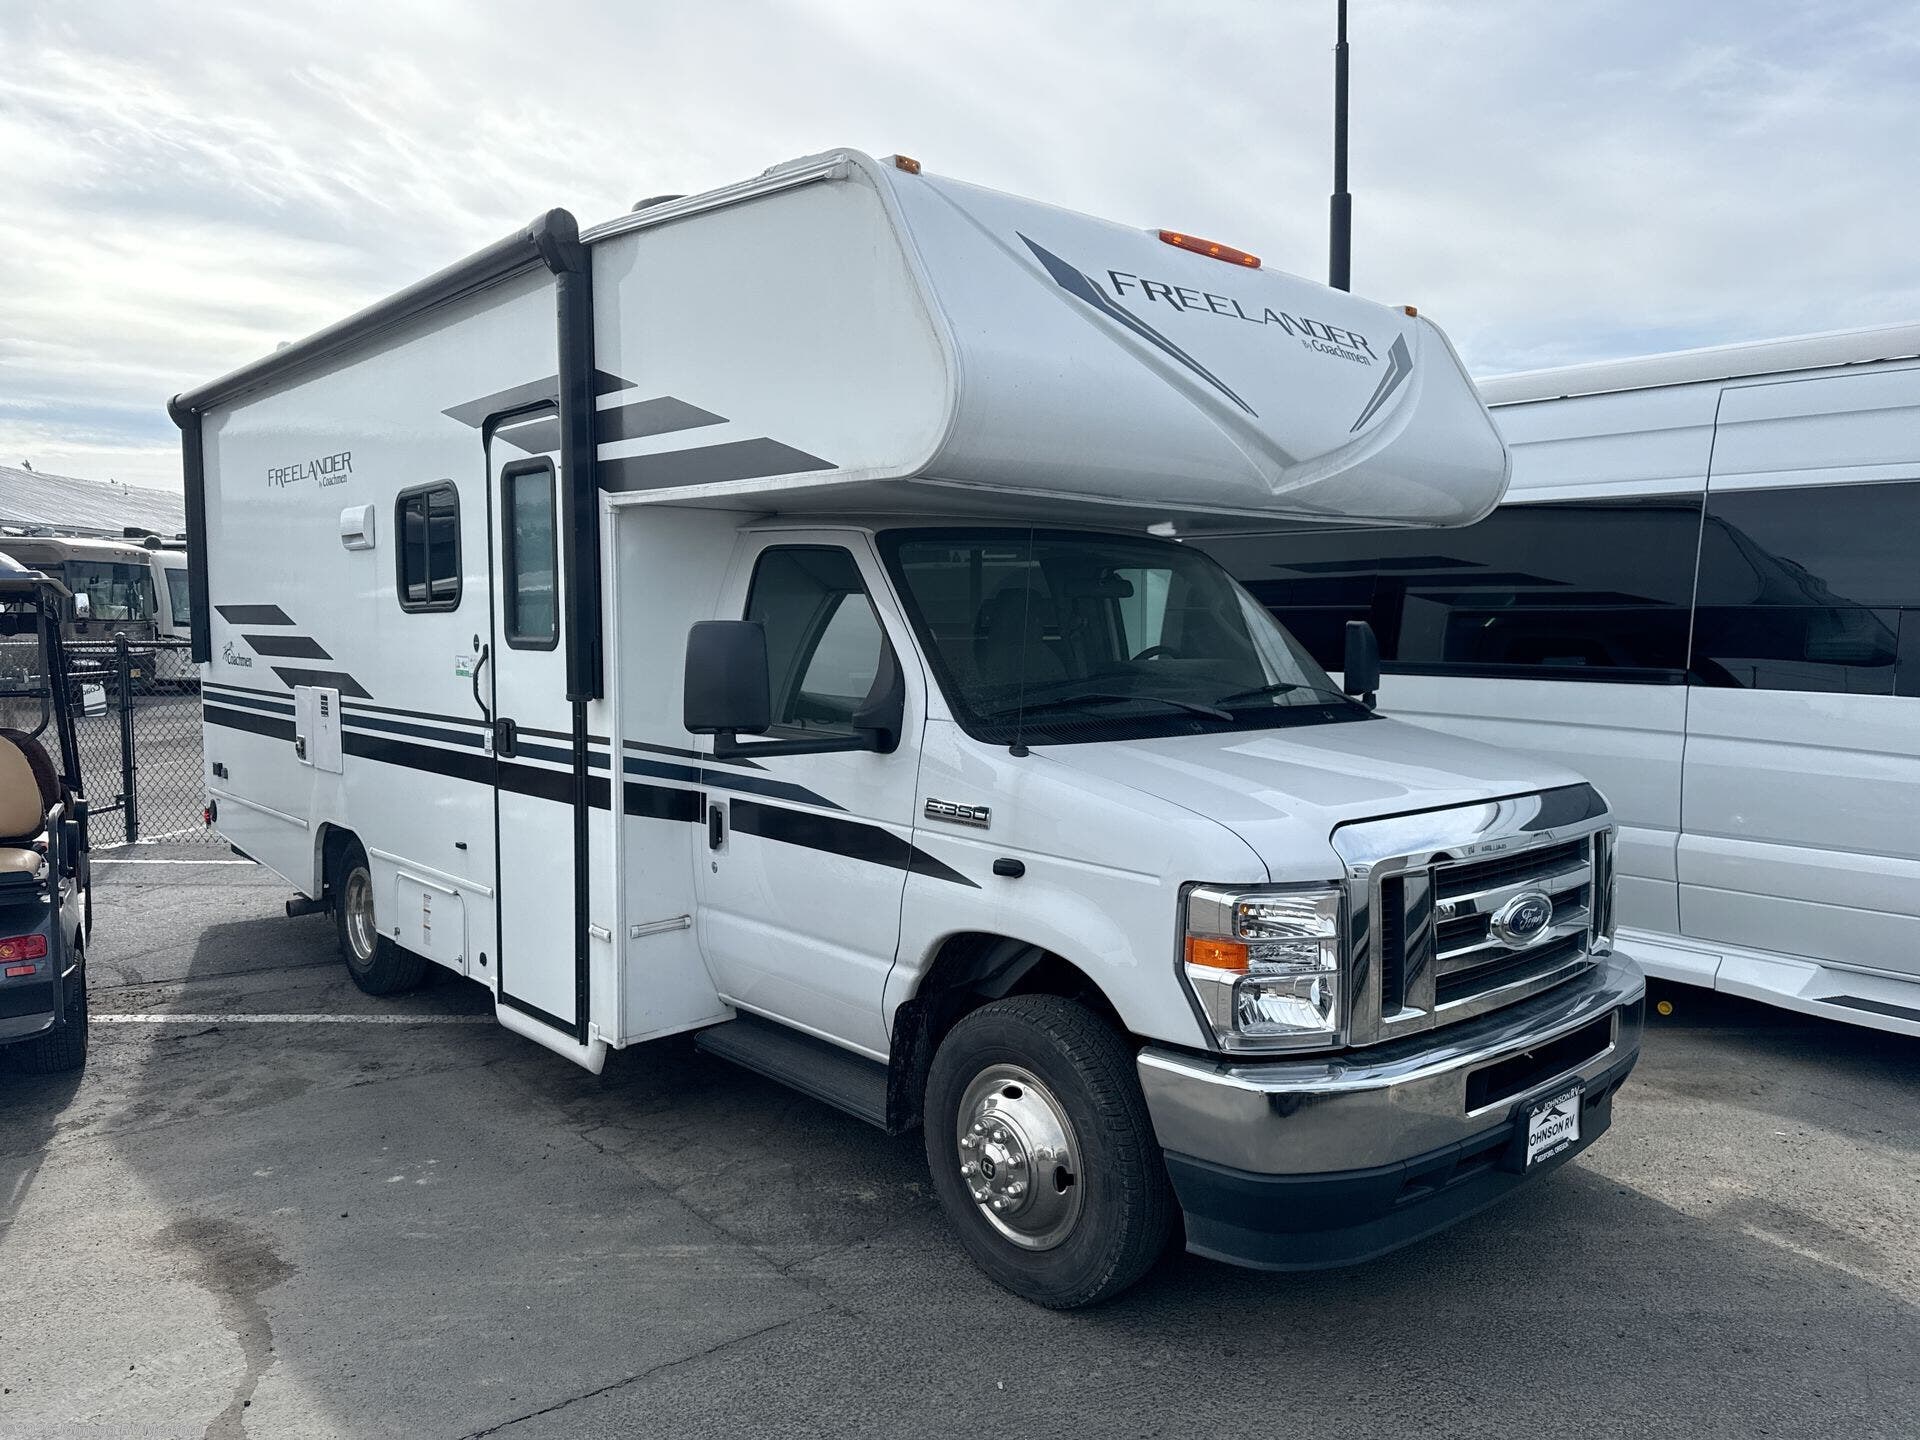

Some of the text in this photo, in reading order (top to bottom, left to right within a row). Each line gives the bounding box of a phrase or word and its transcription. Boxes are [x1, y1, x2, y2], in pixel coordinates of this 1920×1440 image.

[1107, 269, 1378, 361] FREELANDER
[1312, 339, 1371, 366] Coachmen
[267, 451, 353, 488] FREELANDER
[322, 474, 348, 487] Coachmen
[227, 652, 253, 668] Coachmen
[1519, 907, 1544, 930] Ford
[1529, 1120, 1565, 1147] OHNSON
[1564, 1114, 1575, 1129] RV
